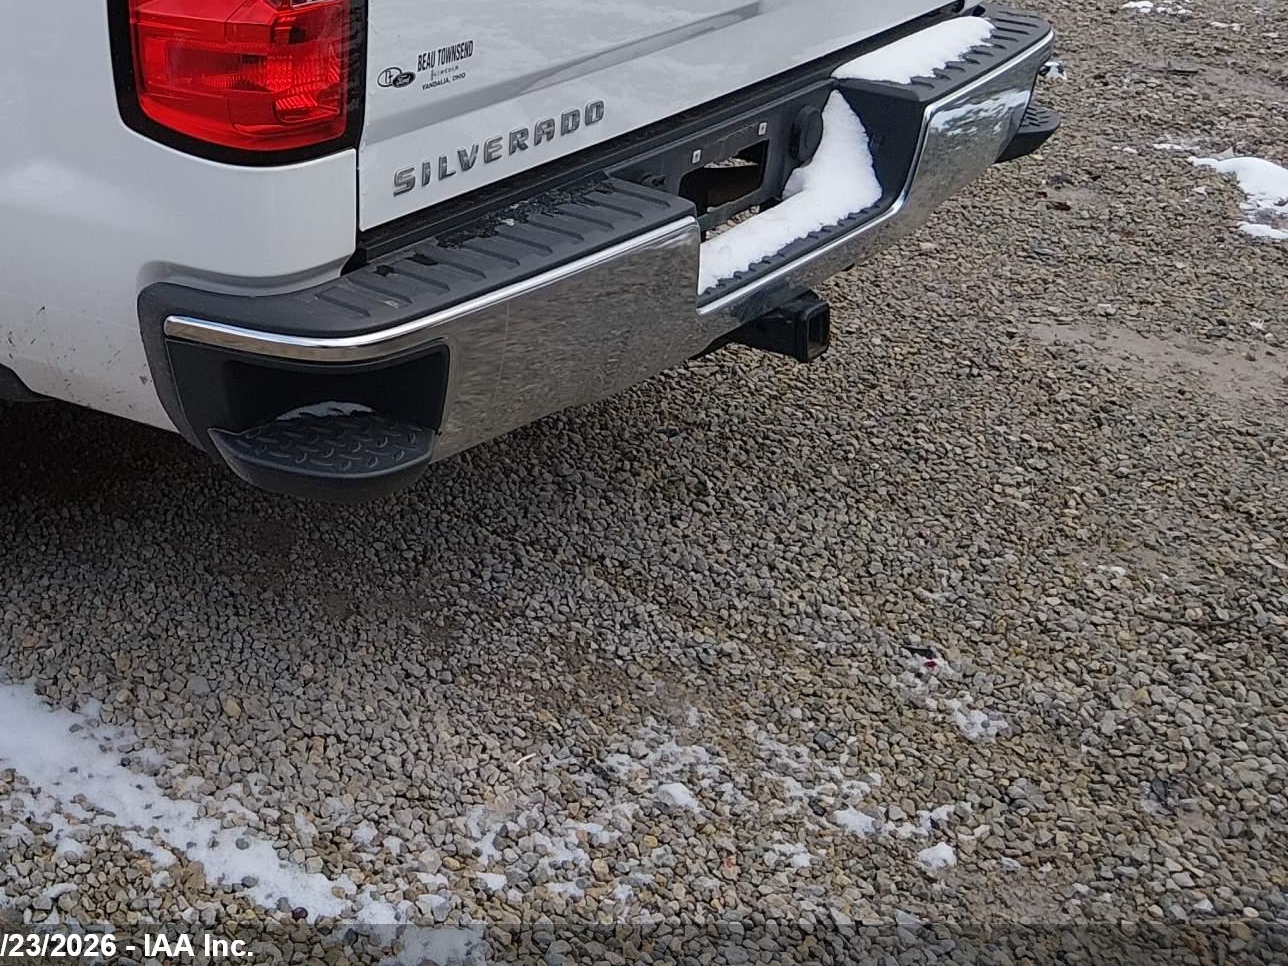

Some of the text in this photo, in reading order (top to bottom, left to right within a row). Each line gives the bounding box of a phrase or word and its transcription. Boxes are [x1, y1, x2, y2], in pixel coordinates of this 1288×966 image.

[417, 40, 474, 72] BEAU TOWNSEND
[393, 100, 605, 197] SILVERADO
